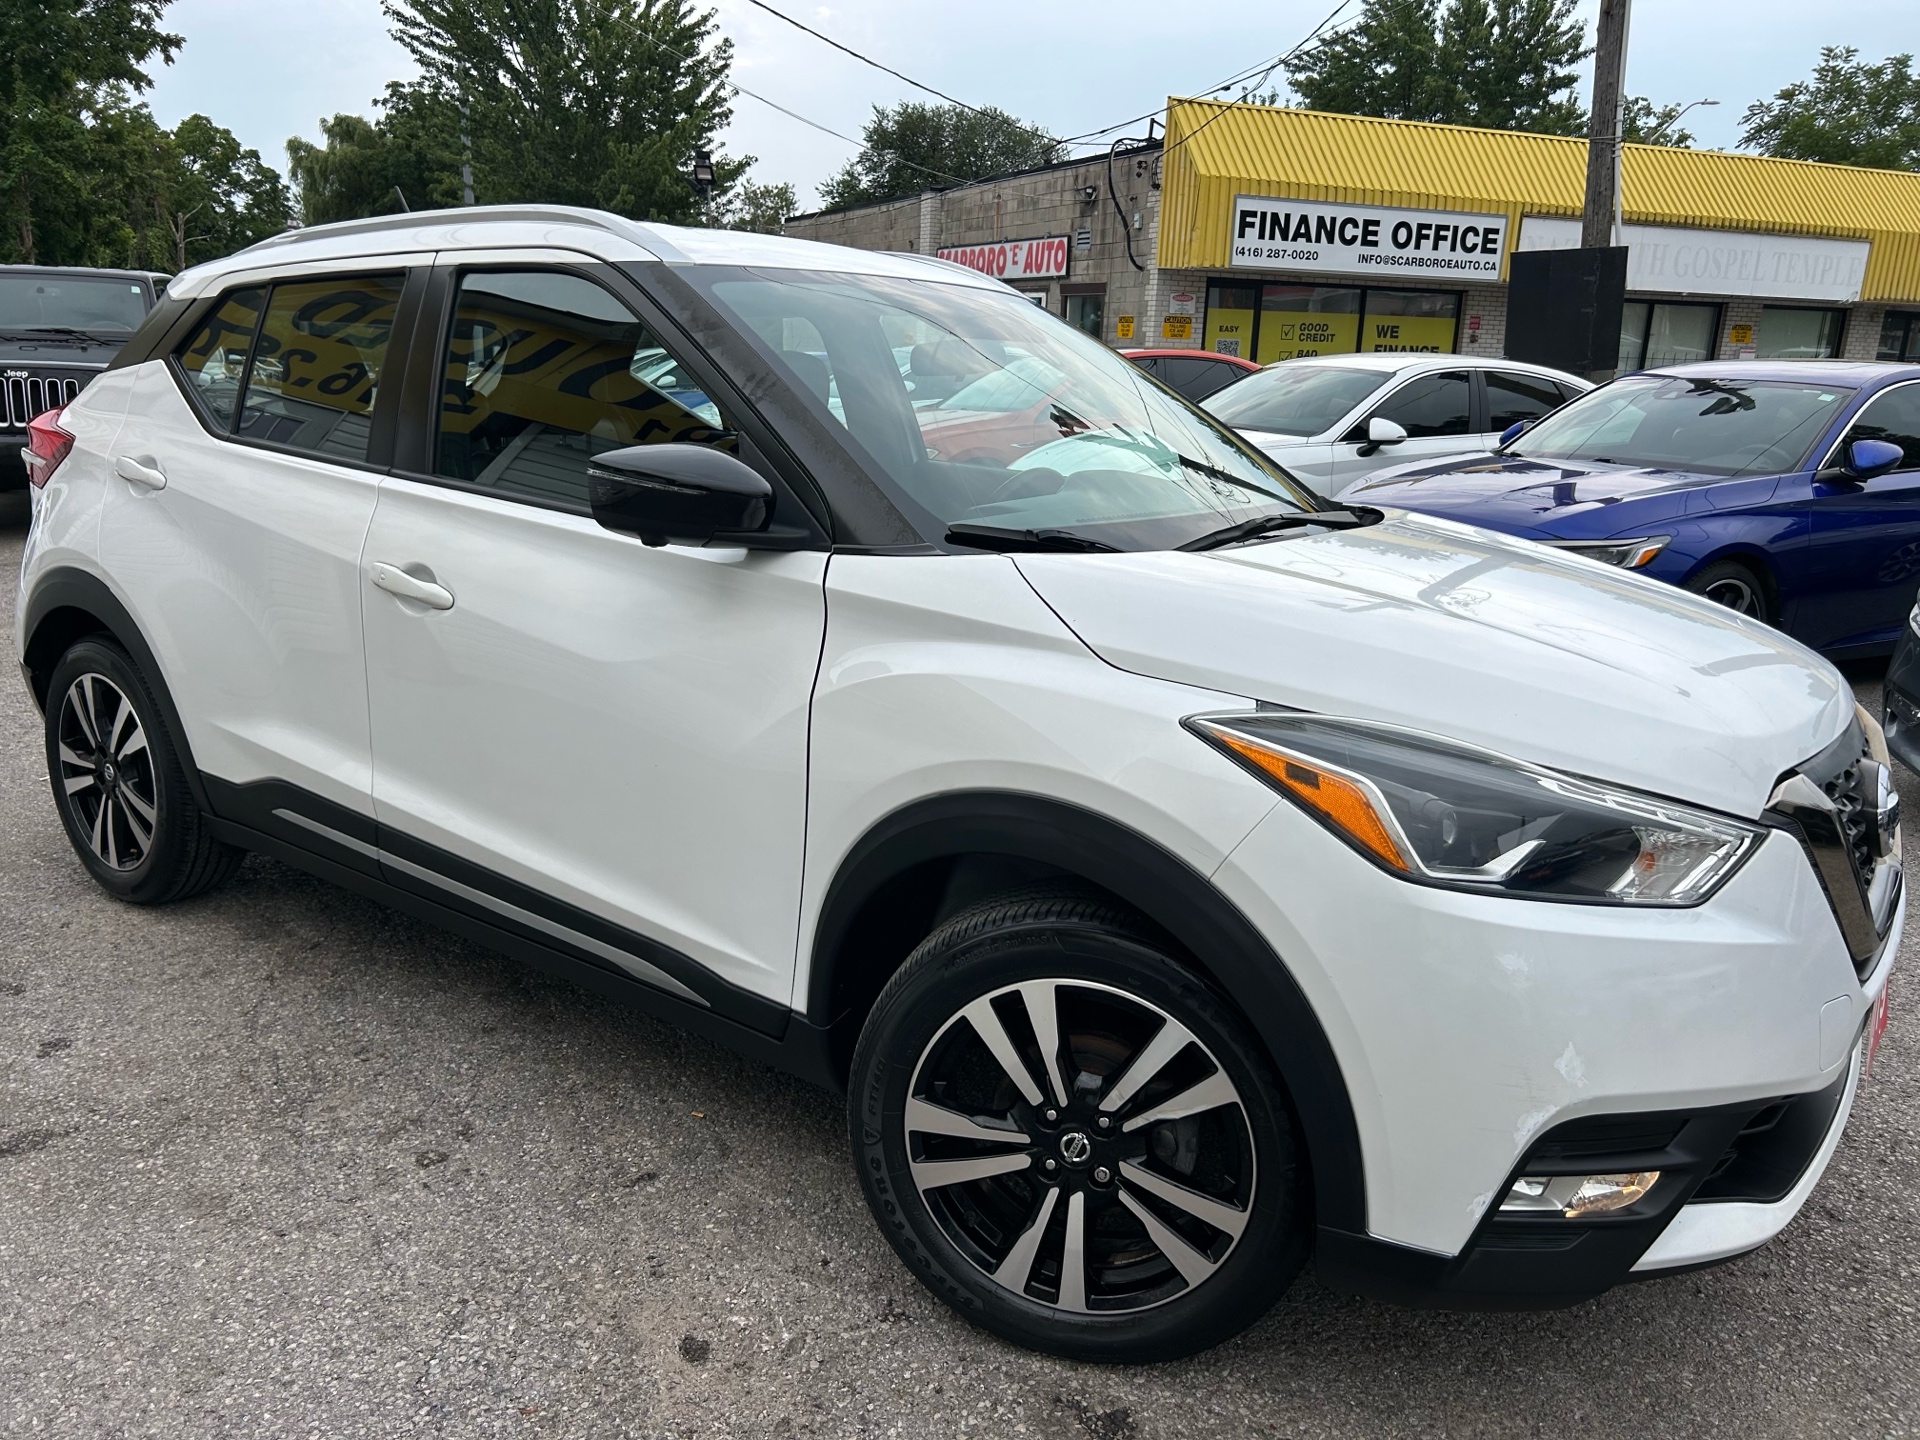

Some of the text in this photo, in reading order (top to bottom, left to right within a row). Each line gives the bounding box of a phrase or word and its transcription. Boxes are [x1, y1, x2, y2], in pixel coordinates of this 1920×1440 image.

[1237, 209, 1500, 255] FINANCE OFFICE
[1023, 239, 1066, 274] AUTO
[1235, 246, 1319, 261] (416) 287-0020
[1357, 253, 1497, 272] INFO@SCARBOROEAUTO.CA
[1673, 244, 1765, 282] GOSPEL
[1772, 252, 1862, 288] TEMPLE
[1219, 325, 1239, 333] EASY
[1299, 323, 1329, 332] GOOD
[1375, 324, 1400, 339] WE
[1298, 333, 1336, 343] CREDIT
[1296, 349, 1318, 359] BAD
[3, 369, 29, 379] Jeep
